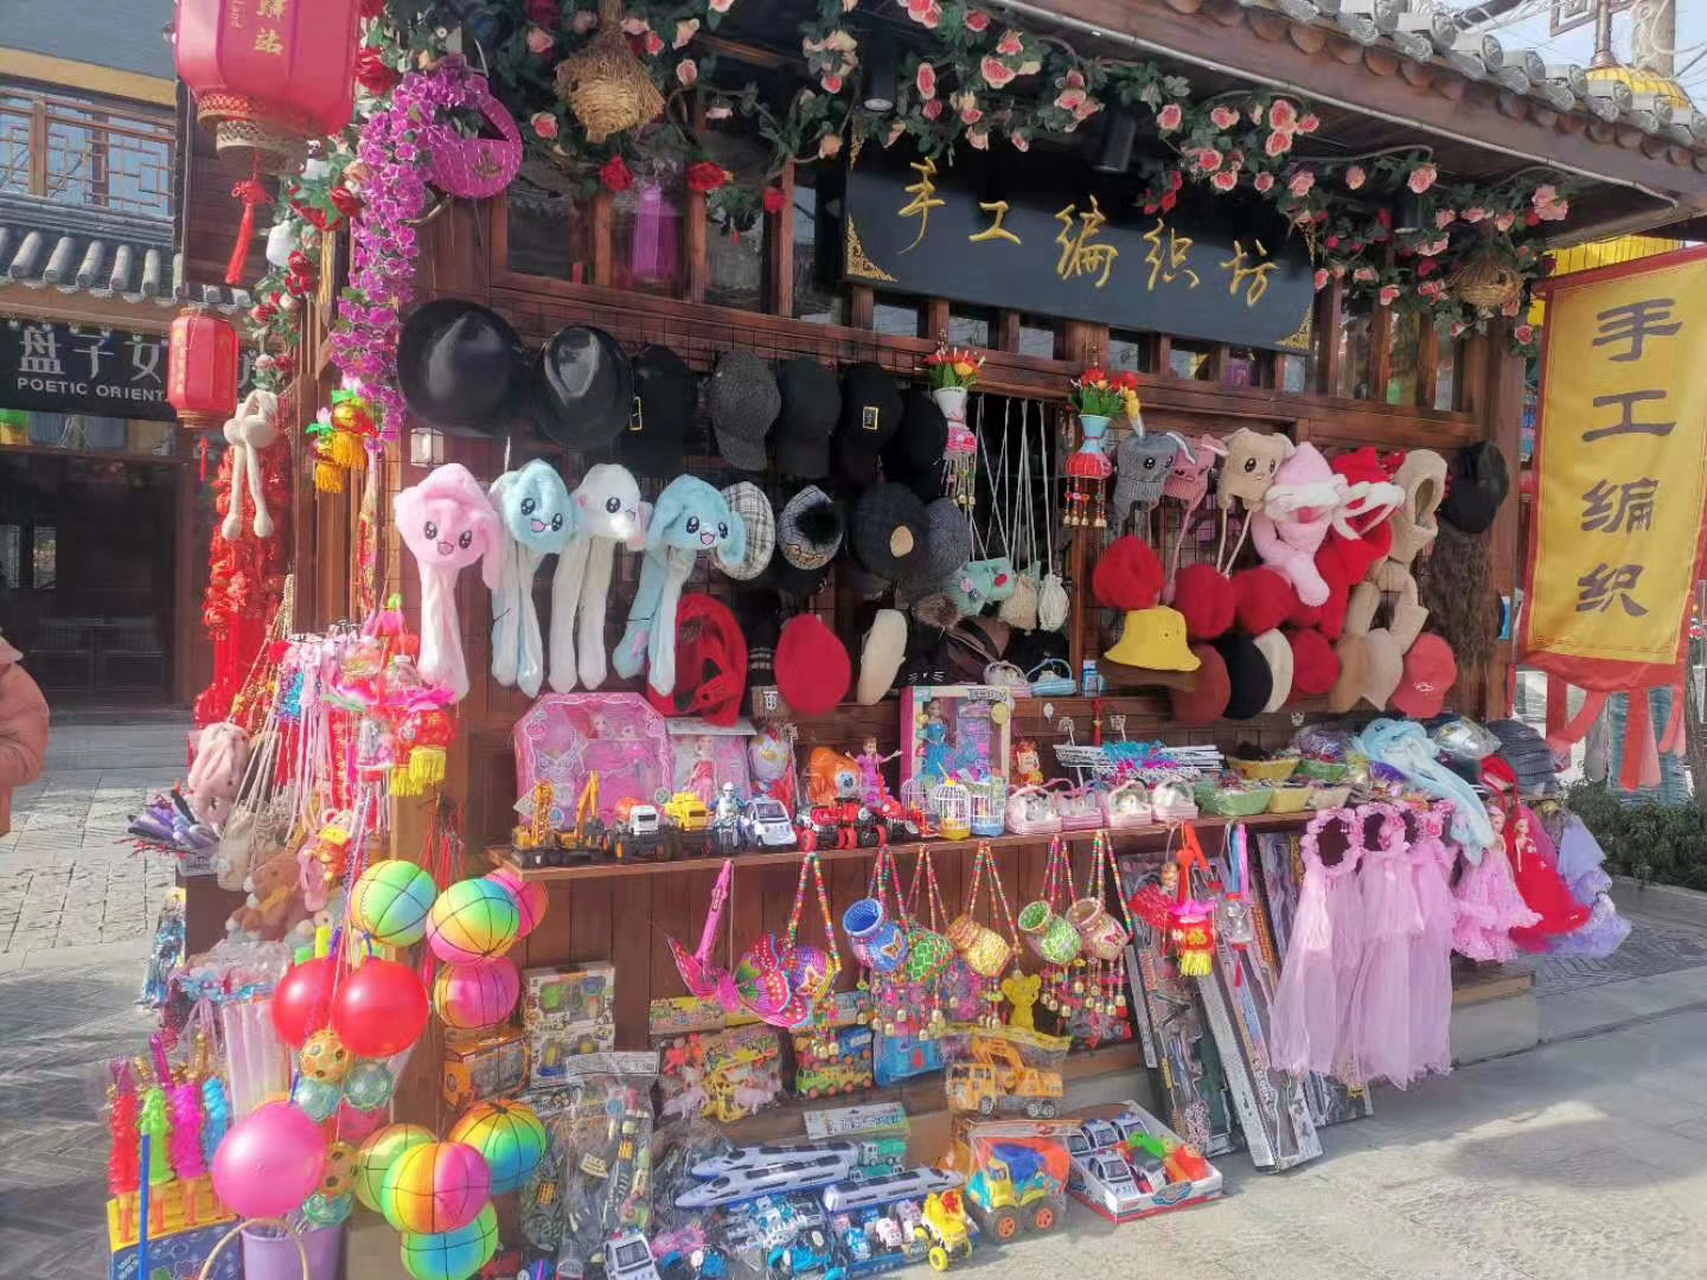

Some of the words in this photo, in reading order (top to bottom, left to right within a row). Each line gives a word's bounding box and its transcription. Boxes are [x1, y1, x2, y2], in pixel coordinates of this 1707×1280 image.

[897, 156, 1281, 307] 手工编织坊
[17, 376, 88, 395] POETIC
[1576, 298, 1683, 617] 手工编织
